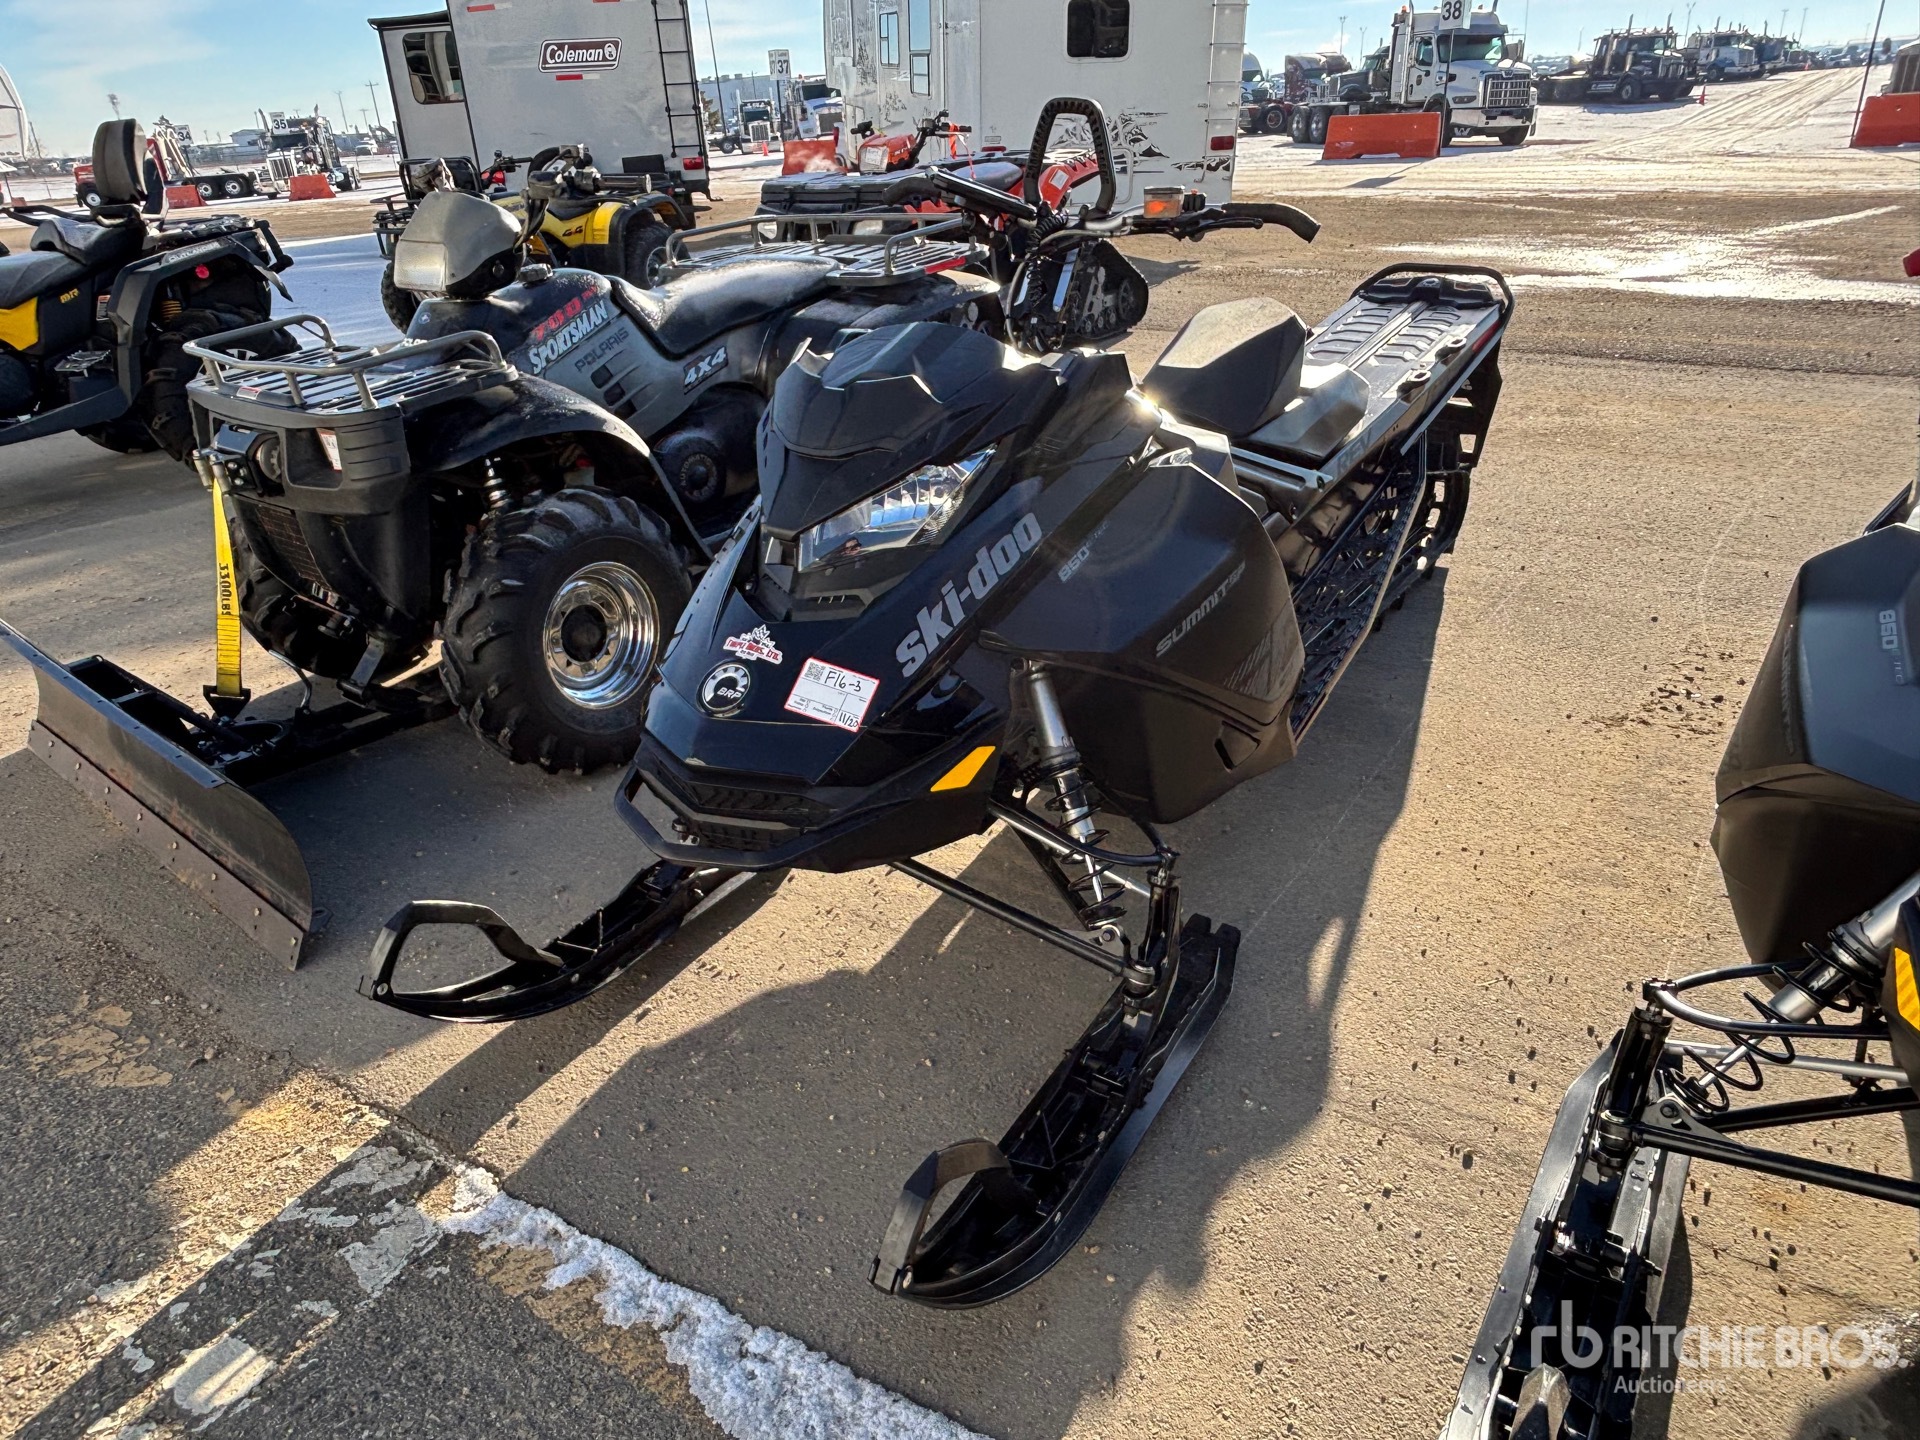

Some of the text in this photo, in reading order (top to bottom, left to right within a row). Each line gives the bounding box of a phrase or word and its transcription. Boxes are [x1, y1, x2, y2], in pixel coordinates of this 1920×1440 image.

[1442, 0, 1462, 20] 38
[546, 44, 603, 63] Coleman
[777, 60, 789, 74] 37
[273, 120, 287, 130] 35
[177, 131, 192, 142] 34
[528, 299, 609, 375] SPORTSMAN
[574, 326, 630, 374] POLARIS
[1057, 547, 1090, 583] 850
[1155, 577, 1230, 658] SUMMIT
[1879, 609, 1898, 650] 850
[824, 670, 862, 693] F16-3
[717, 687, 742, 700] BRP
[839, 711, 859, 728] 11/20
